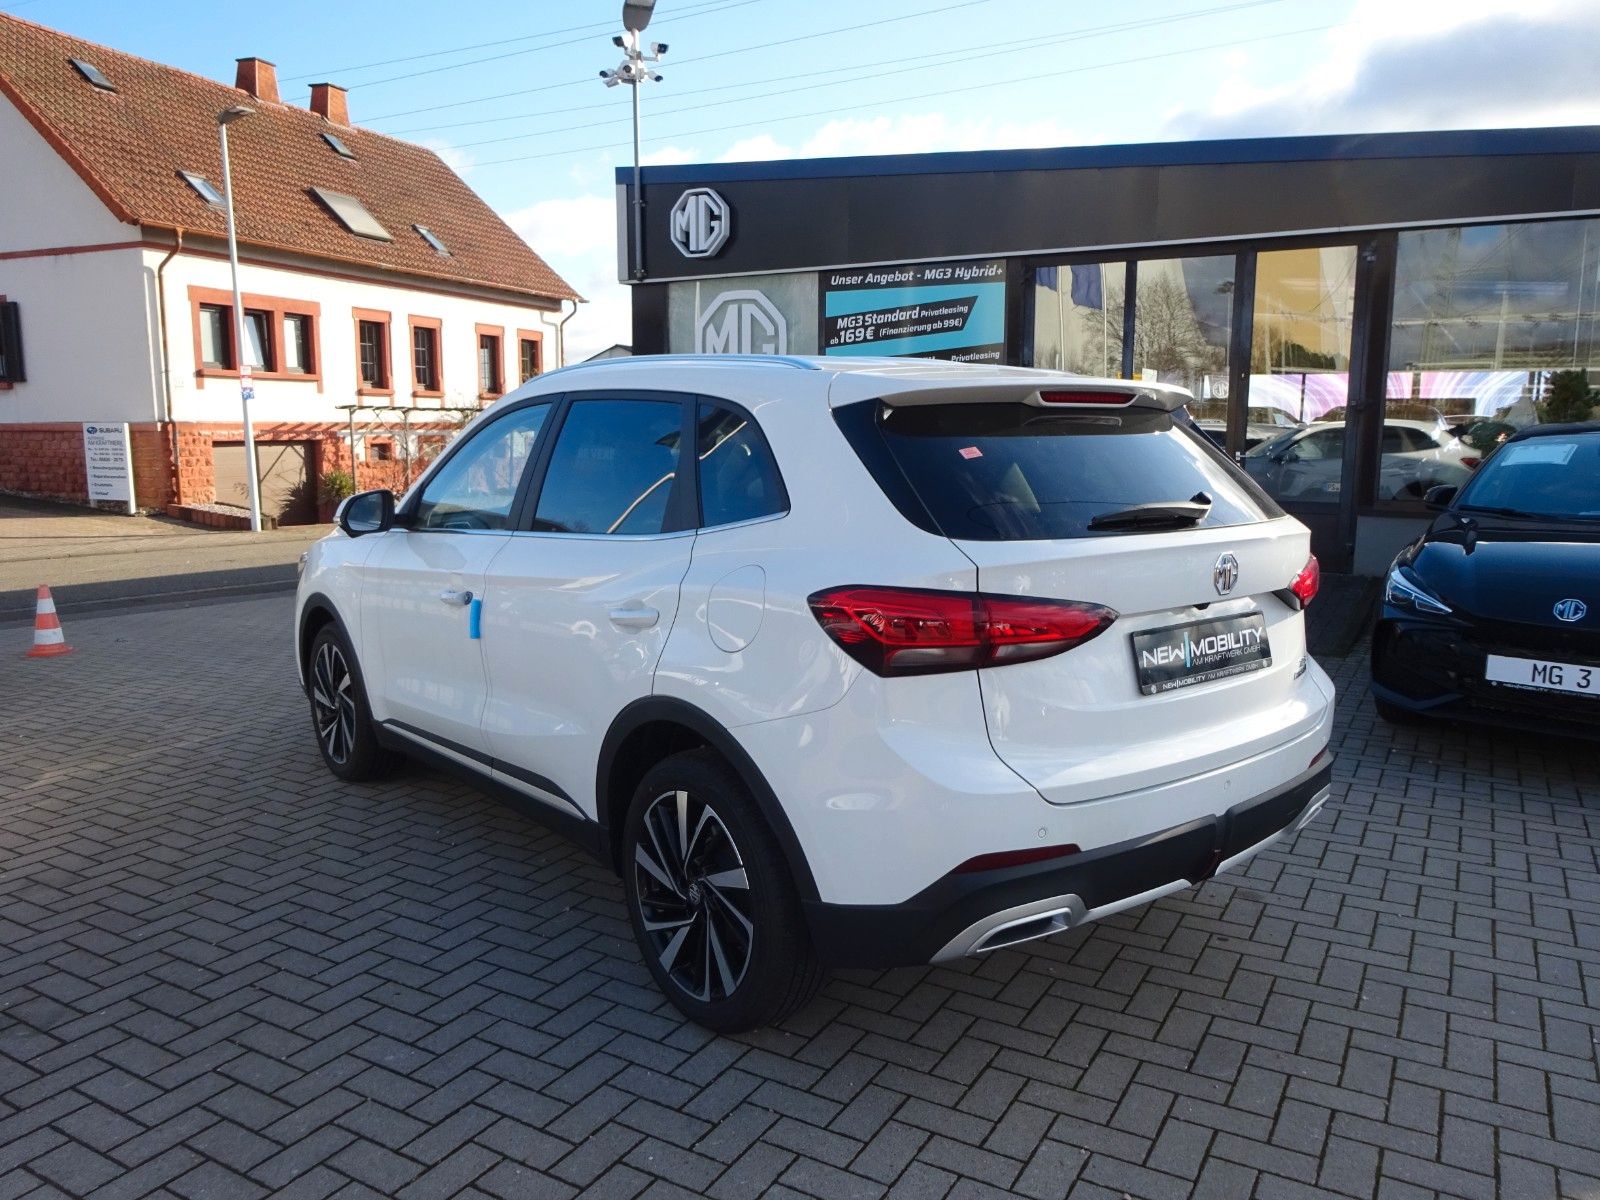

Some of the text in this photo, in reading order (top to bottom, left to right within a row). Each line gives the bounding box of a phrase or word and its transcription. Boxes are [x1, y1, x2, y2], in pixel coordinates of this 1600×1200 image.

[675, 194, 722, 251] MG
[831, 274, 863, 286] Unser
[865, 270, 914, 285] Angebot
[924, 269, 952, 281] MG3
[955, 265, 1003, 281] Hybrid+
[705, 304, 776, 355] MG
[837, 304, 969, 330] MG3 Standard Privatleasing
[830, 318, 963, 345] ab 169€ (Finanzierung ab 99€)
[951, 351, 1000, 362] Privatleasing
[1557, 601, 1584, 619] MG
[1142, 627, 1263, 668] NEW MOBILITY
[1204, 649, 1242, 664] KRAFTWERK
[1531, 663, 1592, 689] MG 3
